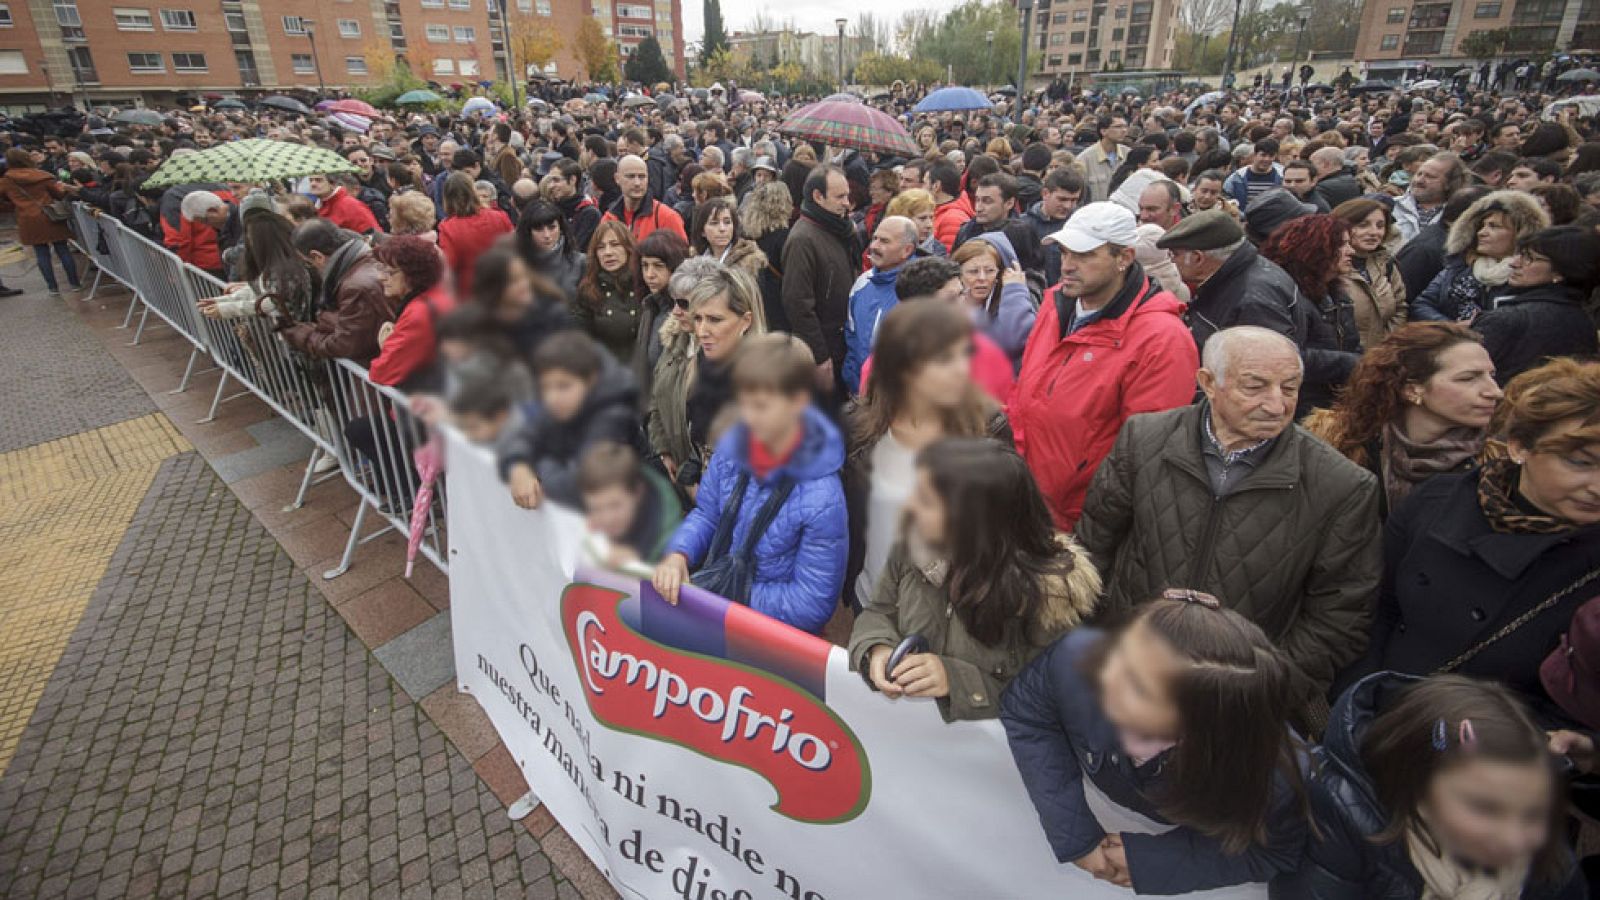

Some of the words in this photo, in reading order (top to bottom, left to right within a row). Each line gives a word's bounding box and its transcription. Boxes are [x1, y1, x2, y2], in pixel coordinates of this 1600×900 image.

[477, 654, 541, 735] nuestra
[619, 830, 664, 873] de
[519, 643, 561, 706] Que
[612, 770, 647, 808] ni
[656, 795, 764, 874] nadie
[576, 610, 832, 770] Campofrío
